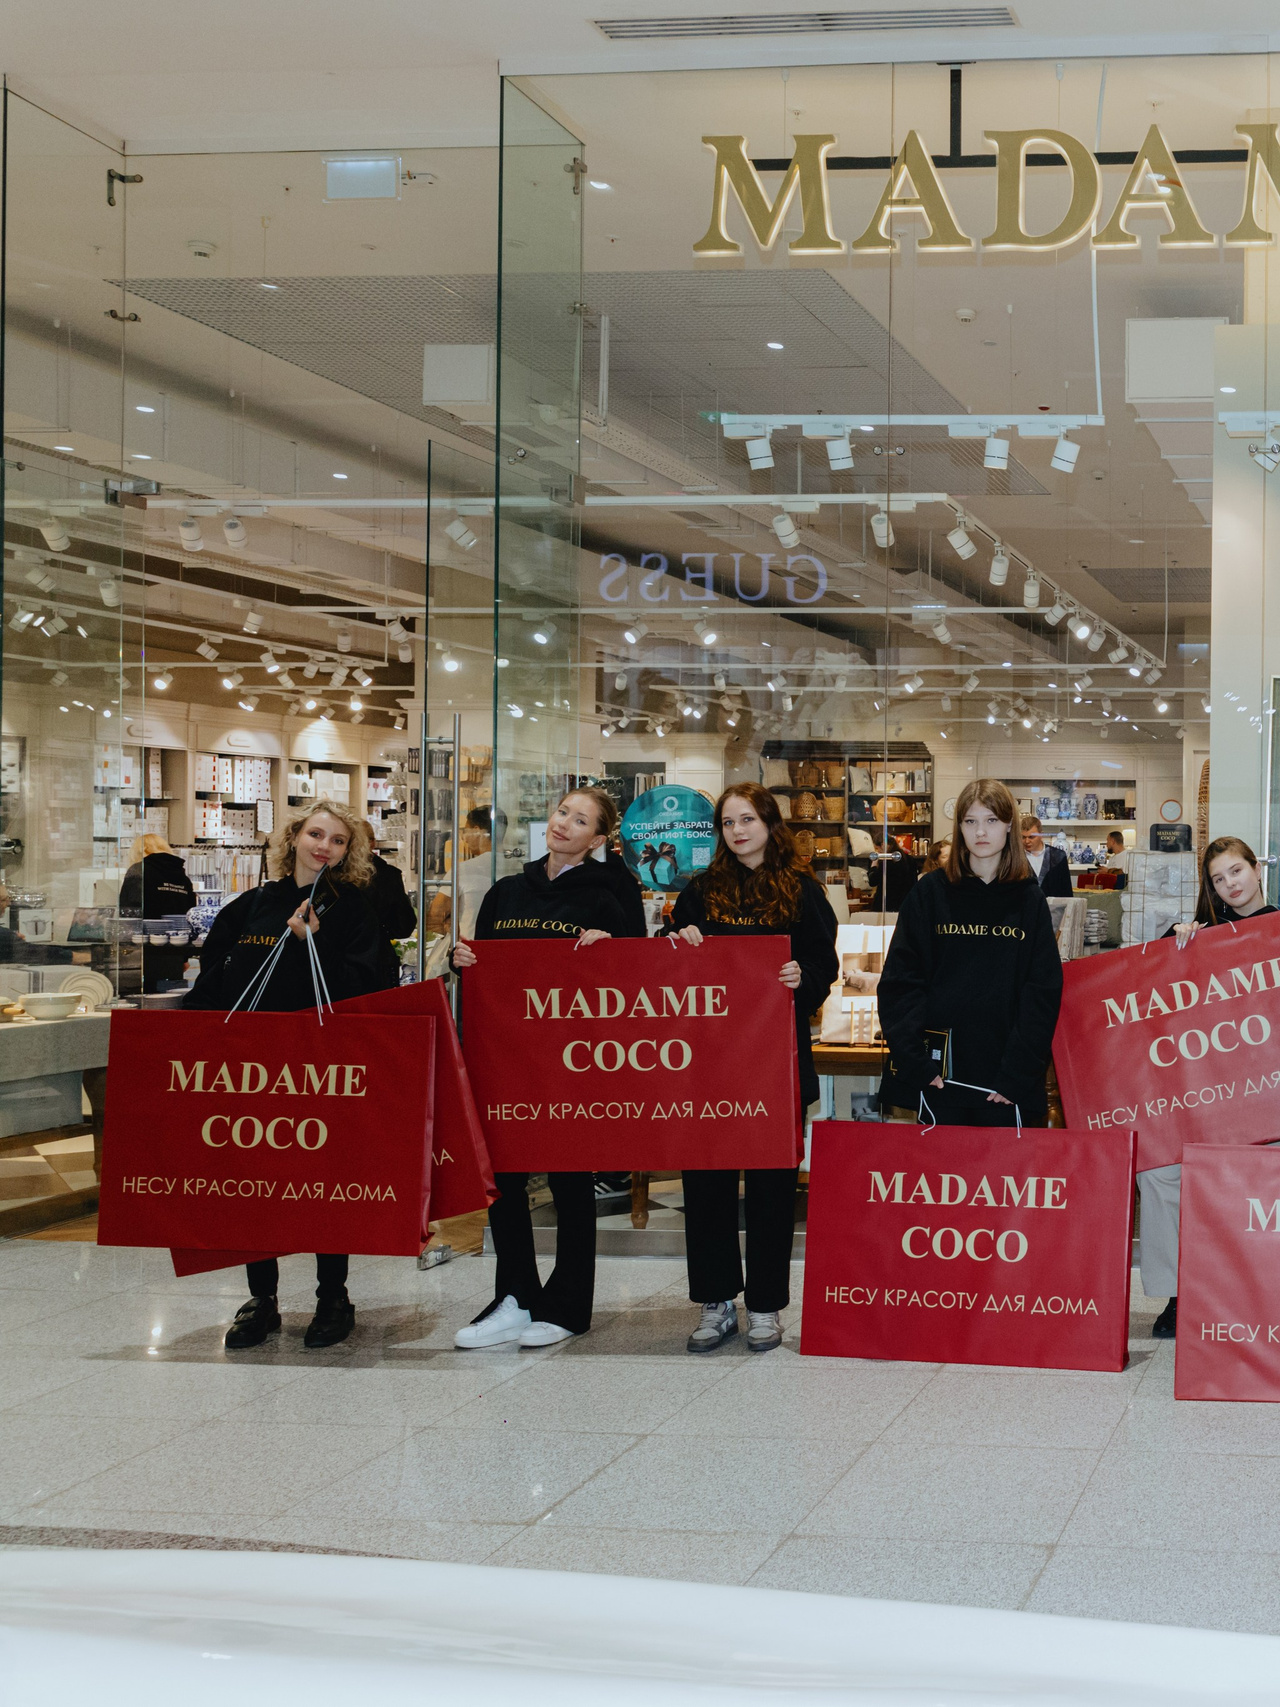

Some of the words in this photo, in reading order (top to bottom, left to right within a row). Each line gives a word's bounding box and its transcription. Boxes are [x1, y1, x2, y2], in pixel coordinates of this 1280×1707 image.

[629, 821, 671, 831] УСПЕЙТЕ
[673, 821, 714, 830] ЗАБРАТЬ
[631, 831, 658, 840] СВОЙ
[660, 830, 712, 839] ГИФТ-БОКС
[524, 986, 728, 1019] MADAME
[563, 1039, 692, 1072] COCO
[1149, 1015, 1271, 1066] COCO
[167, 1061, 366, 1096] MADAME
[488, 1104, 541, 1120] НЕСУ
[550, 1102, 644, 1119] КРАСОТУ
[651, 1101, 693, 1120] ДЛЯ
[700, 1101, 768, 1119] ДОМА
[1088, 1105, 1138, 1130] НЕСУ
[1145, 1082, 1235, 1117] КРАСОТУ
[202, 1115, 327, 1150] COCO
[123, 1177, 176, 1194] НЕСУ
[184, 1178, 276, 1197] КРАСОТУ
[282, 1182, 324, 1200] ДЛЯ
[330, 1183, 396, 1201] ДОМА
[867, 1172, 1067, 1209] MADAME
[902, 1227, 1028, 1262] COCO
[826, 1286, 878, 1305] НЕСУ
[885, 1289, 977, 1309] КРАСОТУ
[983, 1294, 1025, 1313] ДЛЯ
[1031, 1296, 1098, 1315] ДОМА
[1202, 1323, 1260, 1342] НЕСУ
